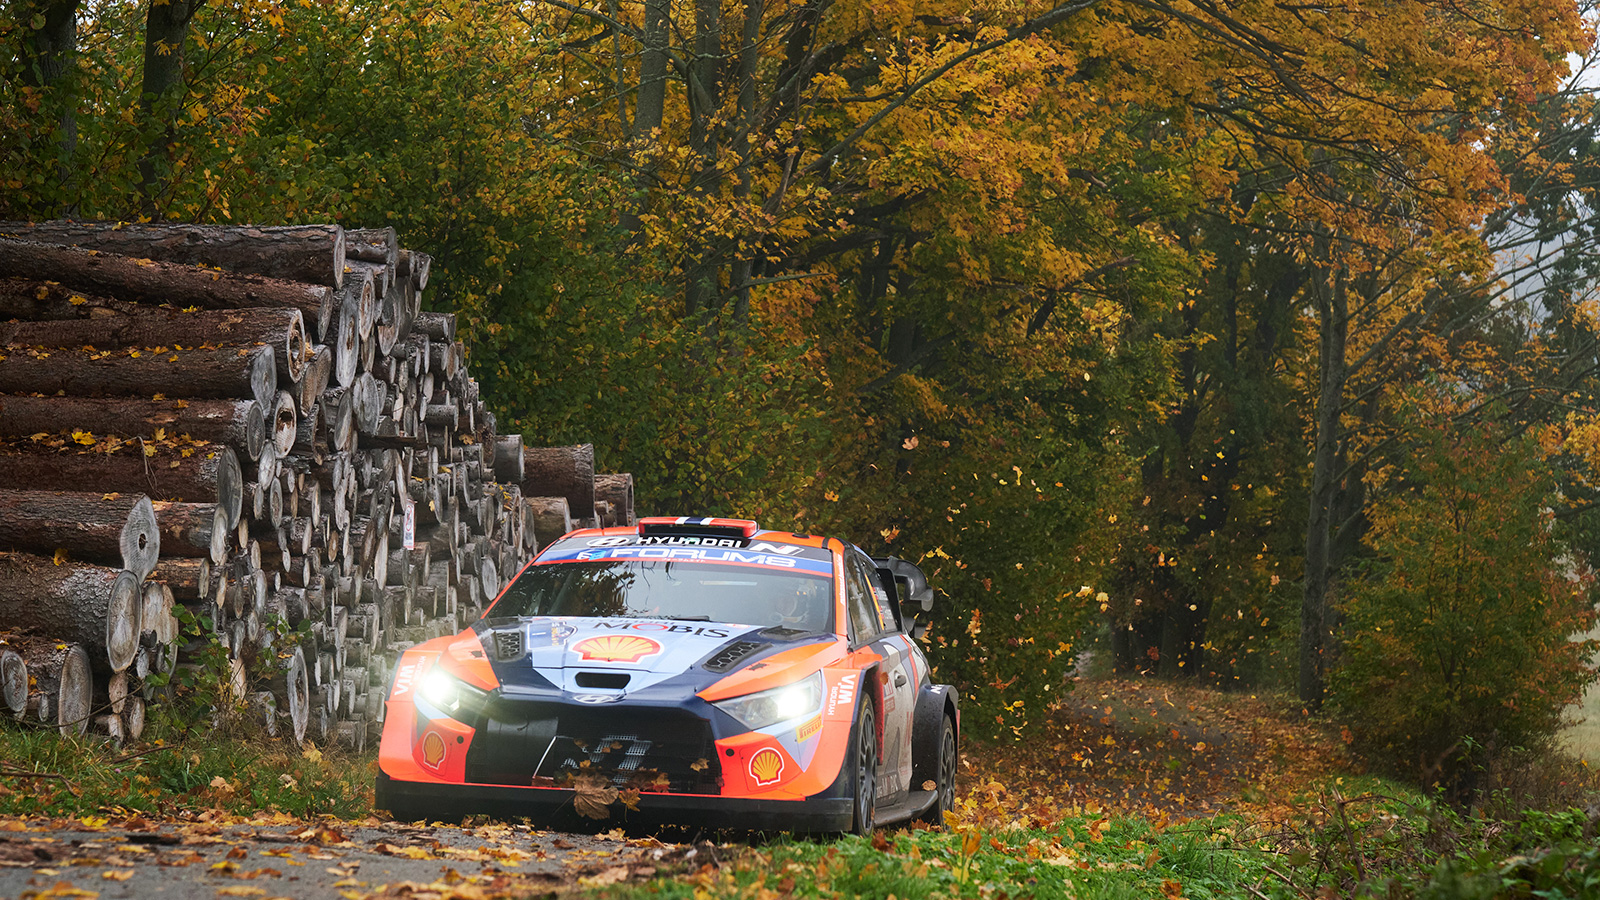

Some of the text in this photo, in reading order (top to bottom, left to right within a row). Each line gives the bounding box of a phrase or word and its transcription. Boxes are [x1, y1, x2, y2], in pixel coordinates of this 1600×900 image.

[635, 536, 742, 548] HYUNDAI
[610, 548, 796, 568] FORUM8
[593, 622, 729, 639] MOBIS
[827, 686, 839, 716] HYUNDAI
